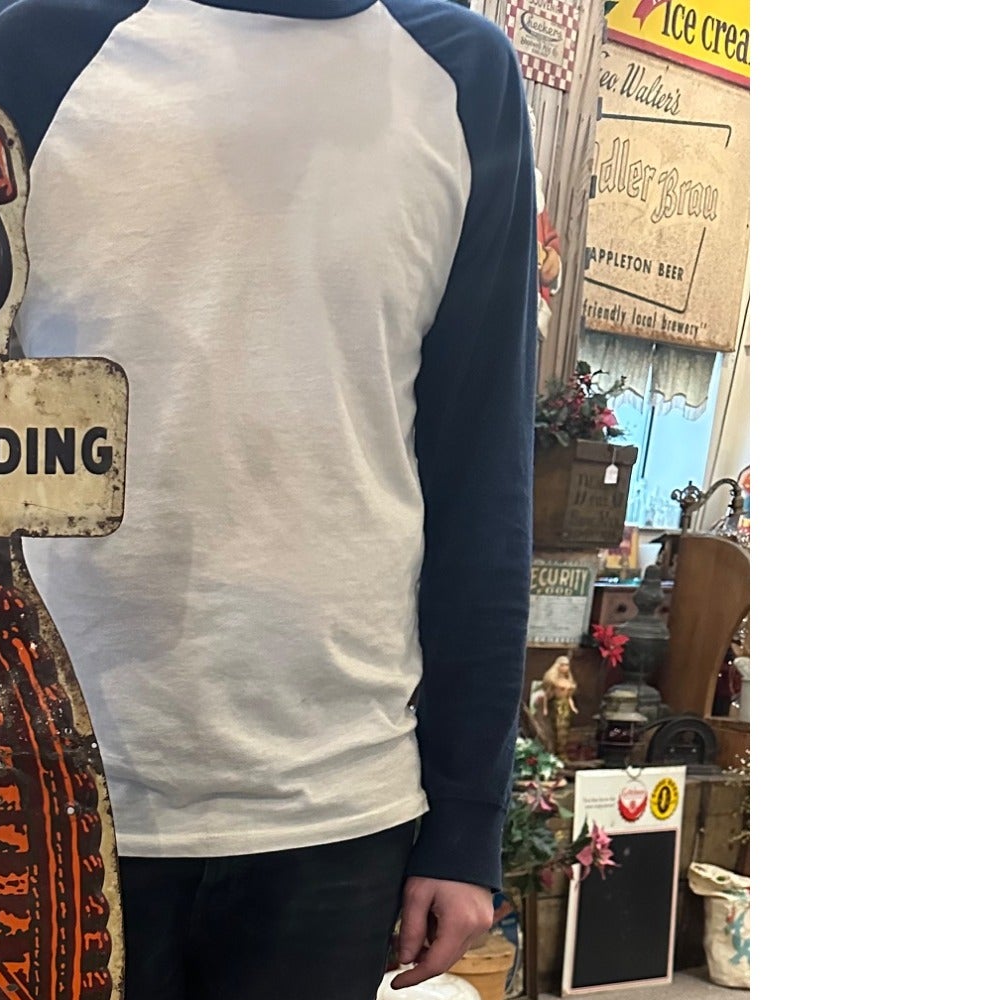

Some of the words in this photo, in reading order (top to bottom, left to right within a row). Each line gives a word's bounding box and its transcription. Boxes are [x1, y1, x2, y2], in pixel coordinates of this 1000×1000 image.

[701, 15, 750, 65] crea
[620, 62, 682, 116] Walter's
[595, 136, 657, 202] dler
[650, 167, 719, 224] Brau
[589, 247, 652, 274] APPLETON
[658, 262, 684, 281] BEER
[583, 298, 626, 327] friendly
[632, 307, 657, 328] local
